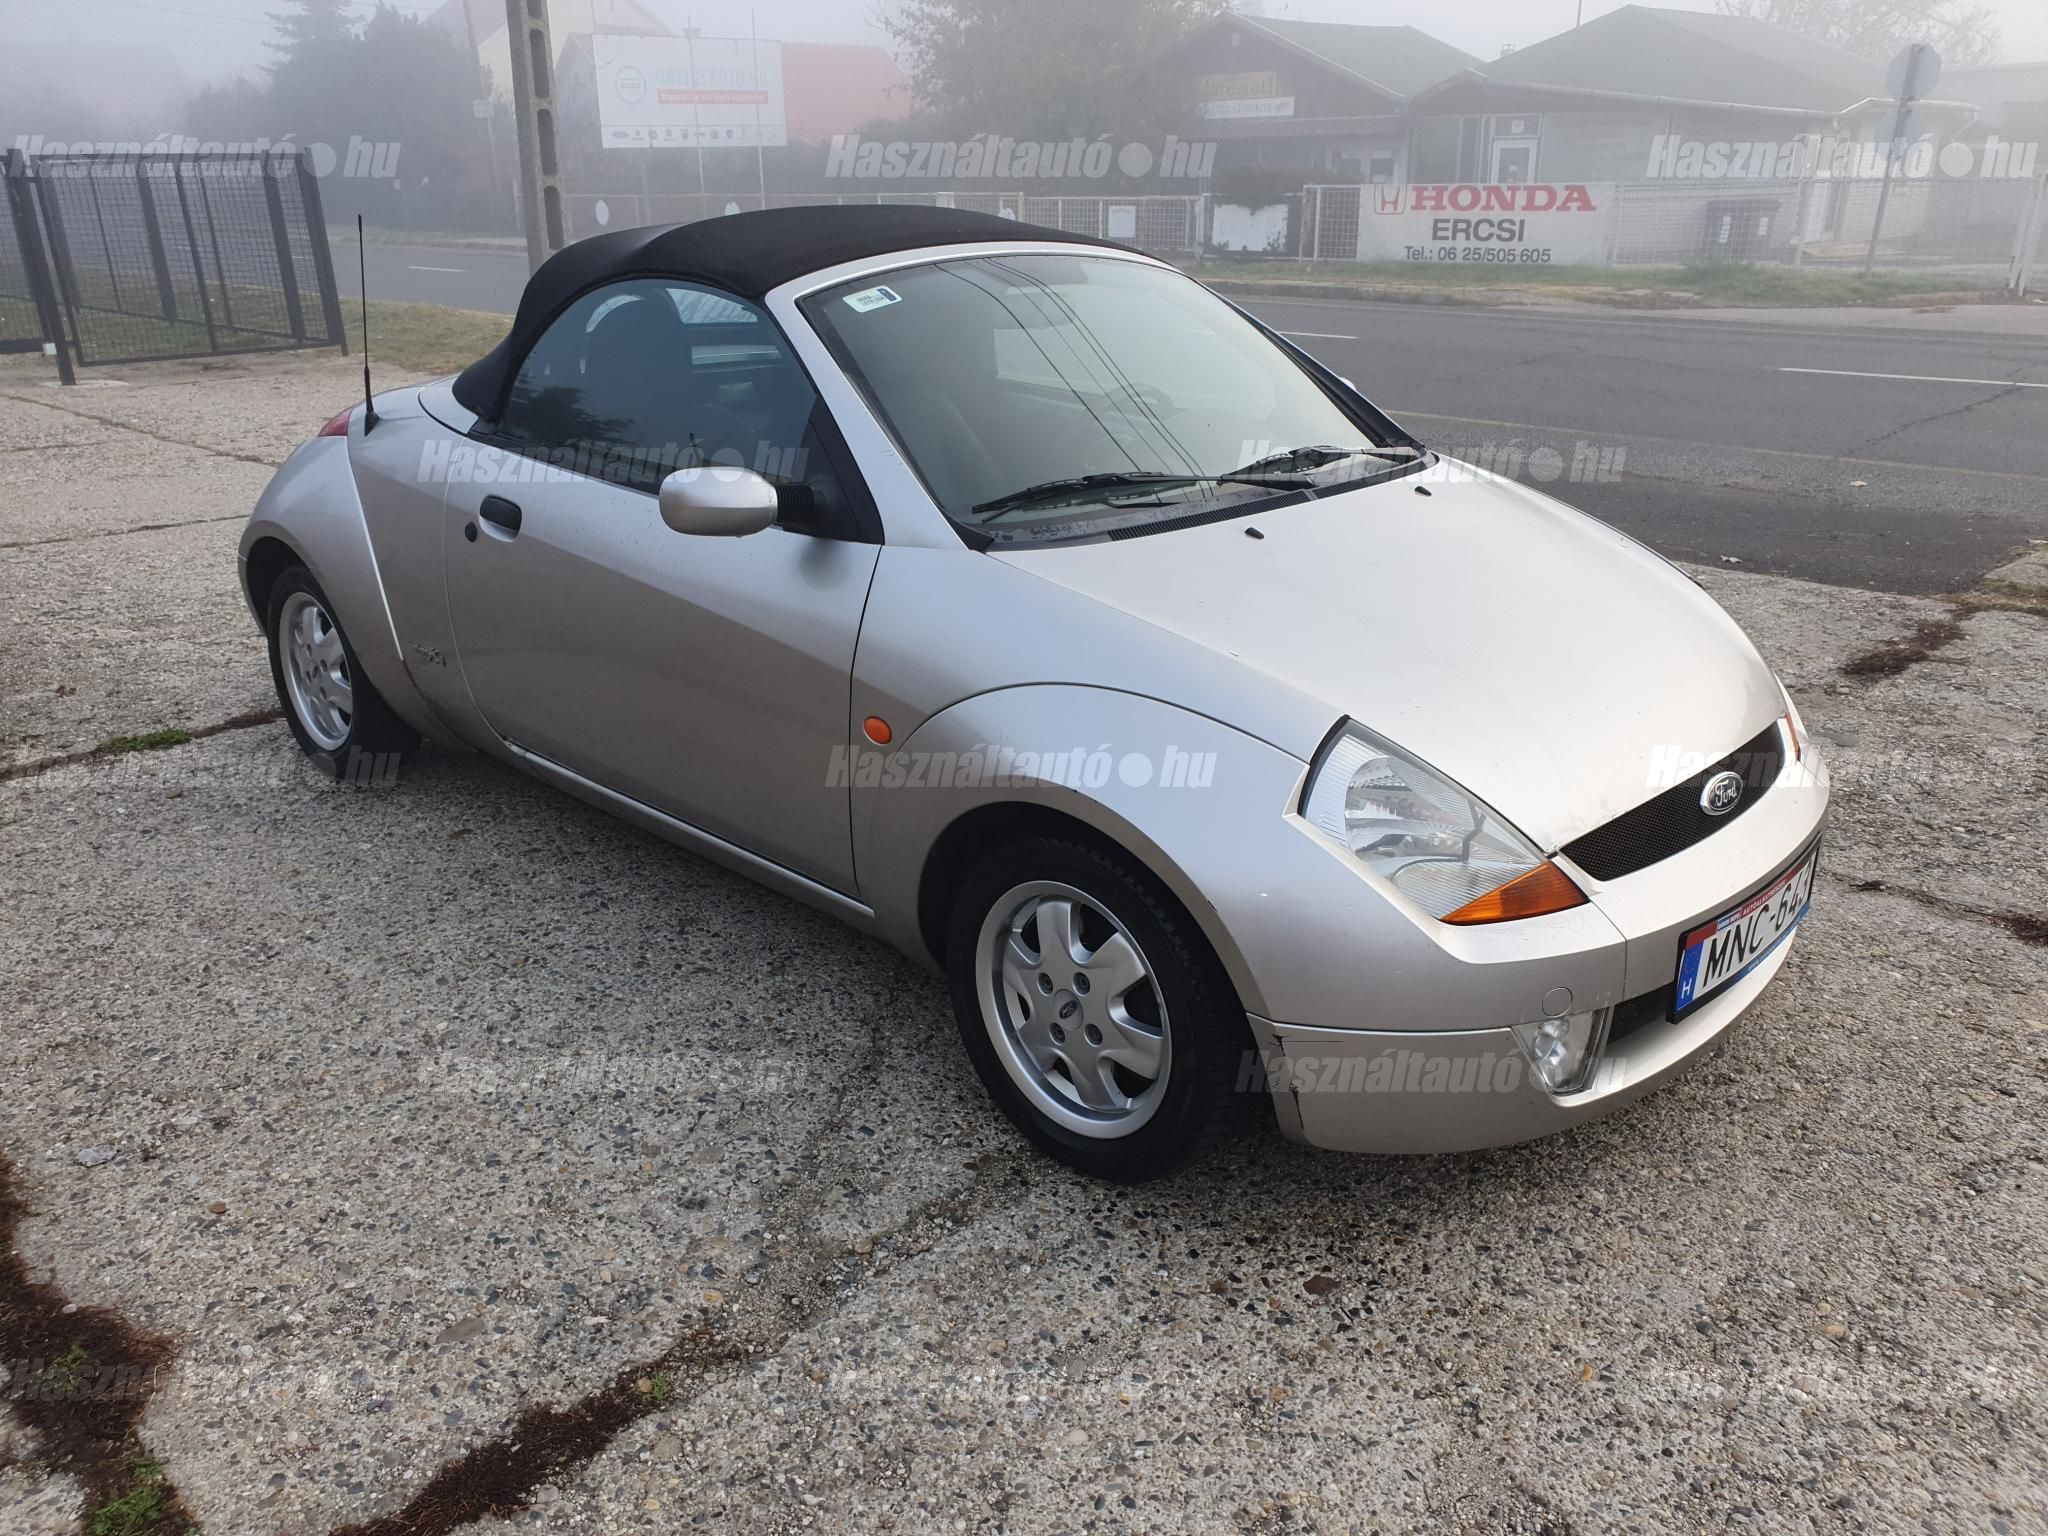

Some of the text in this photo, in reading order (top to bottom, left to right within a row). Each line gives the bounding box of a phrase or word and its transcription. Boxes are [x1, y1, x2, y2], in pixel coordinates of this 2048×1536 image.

[1411, 184, 1597, 212] HONDA
[1432, 218, 1526, 242] ERCSI
[1404, 245, 1433, 261] Tel.:
[1438, 246, 1457, 261] 06
[1714, 779, 1737, 807] Ford
[1681, 977, 1692, 999] H
